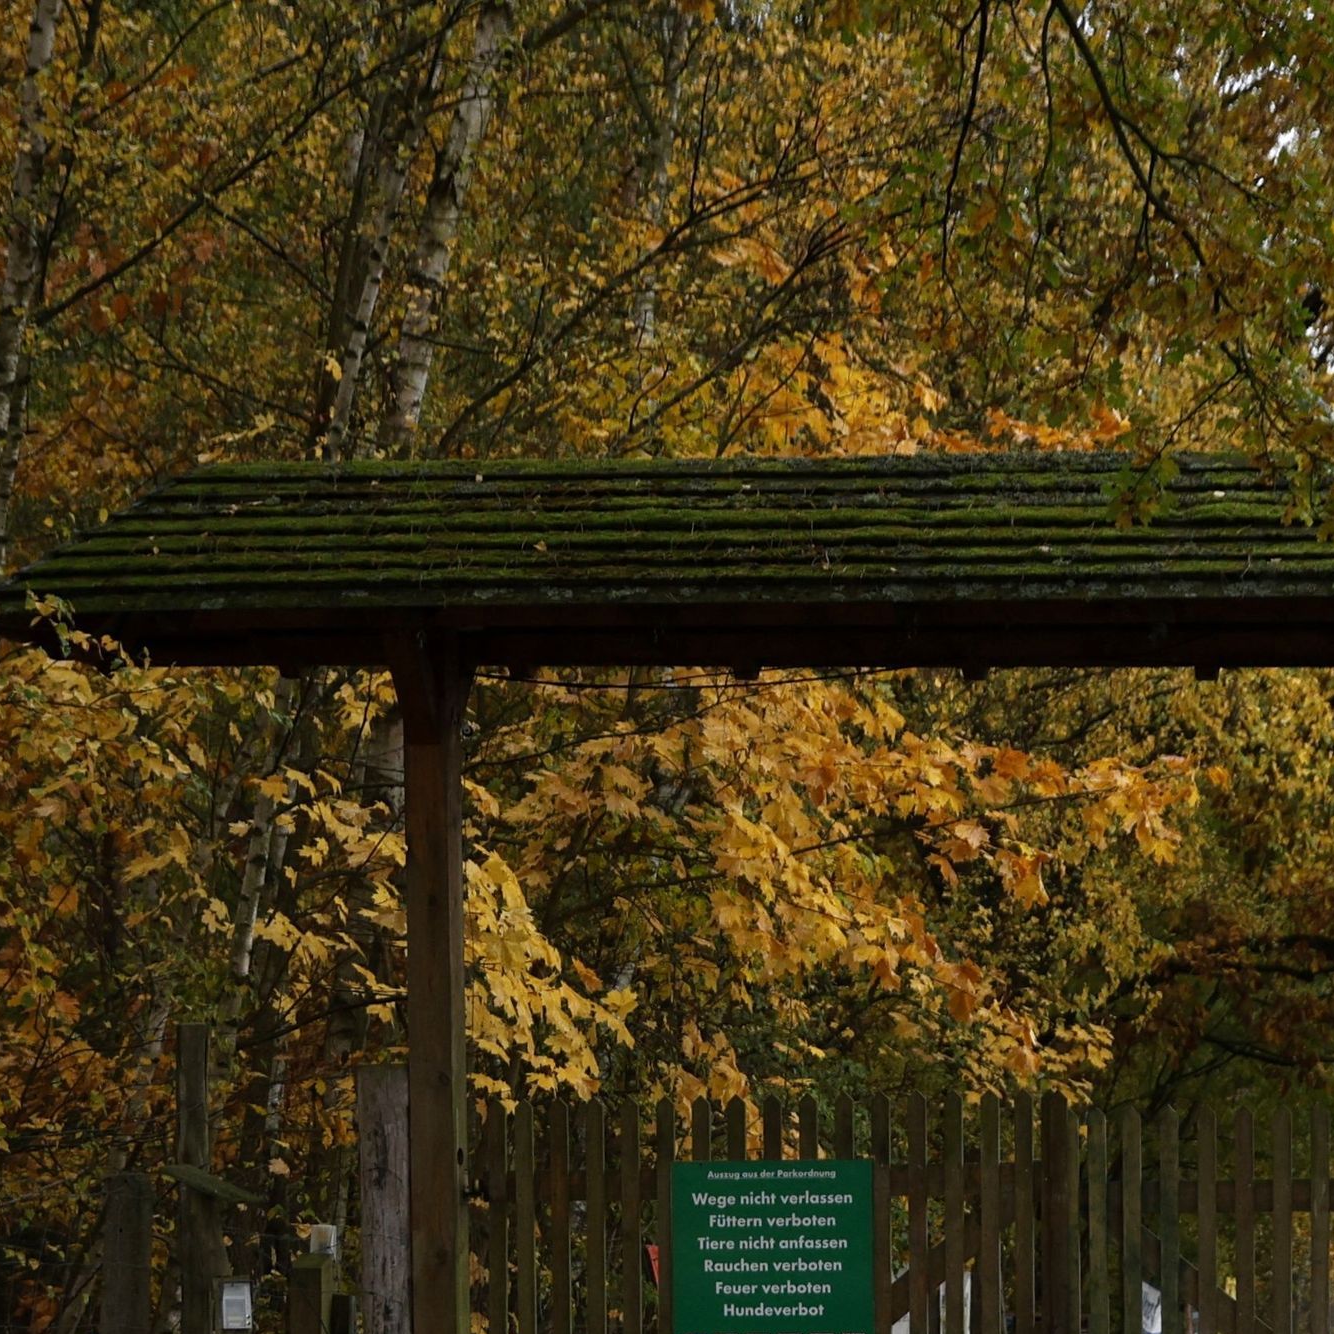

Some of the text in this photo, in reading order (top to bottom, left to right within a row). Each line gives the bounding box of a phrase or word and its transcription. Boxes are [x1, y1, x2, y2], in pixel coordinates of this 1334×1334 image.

[707, 1170, 740, 1179] Auszug
[760, 1169, 775, 1178] der
[777, 1169, 836, 1179] Parkordnung
[692, 1191, 853, 1208] Wege nicht verlassen
[709, 1213, 836, 1228] Füttern verboten
[697, 1235, 848, 1250] Tiere nicht anfassen
[704, 1258, 843, 1272] Rauchen verboten
[715, 1280, 832, 1294] Feuer verboten
[723, 1303, 825, 1317] Hundeverbot
